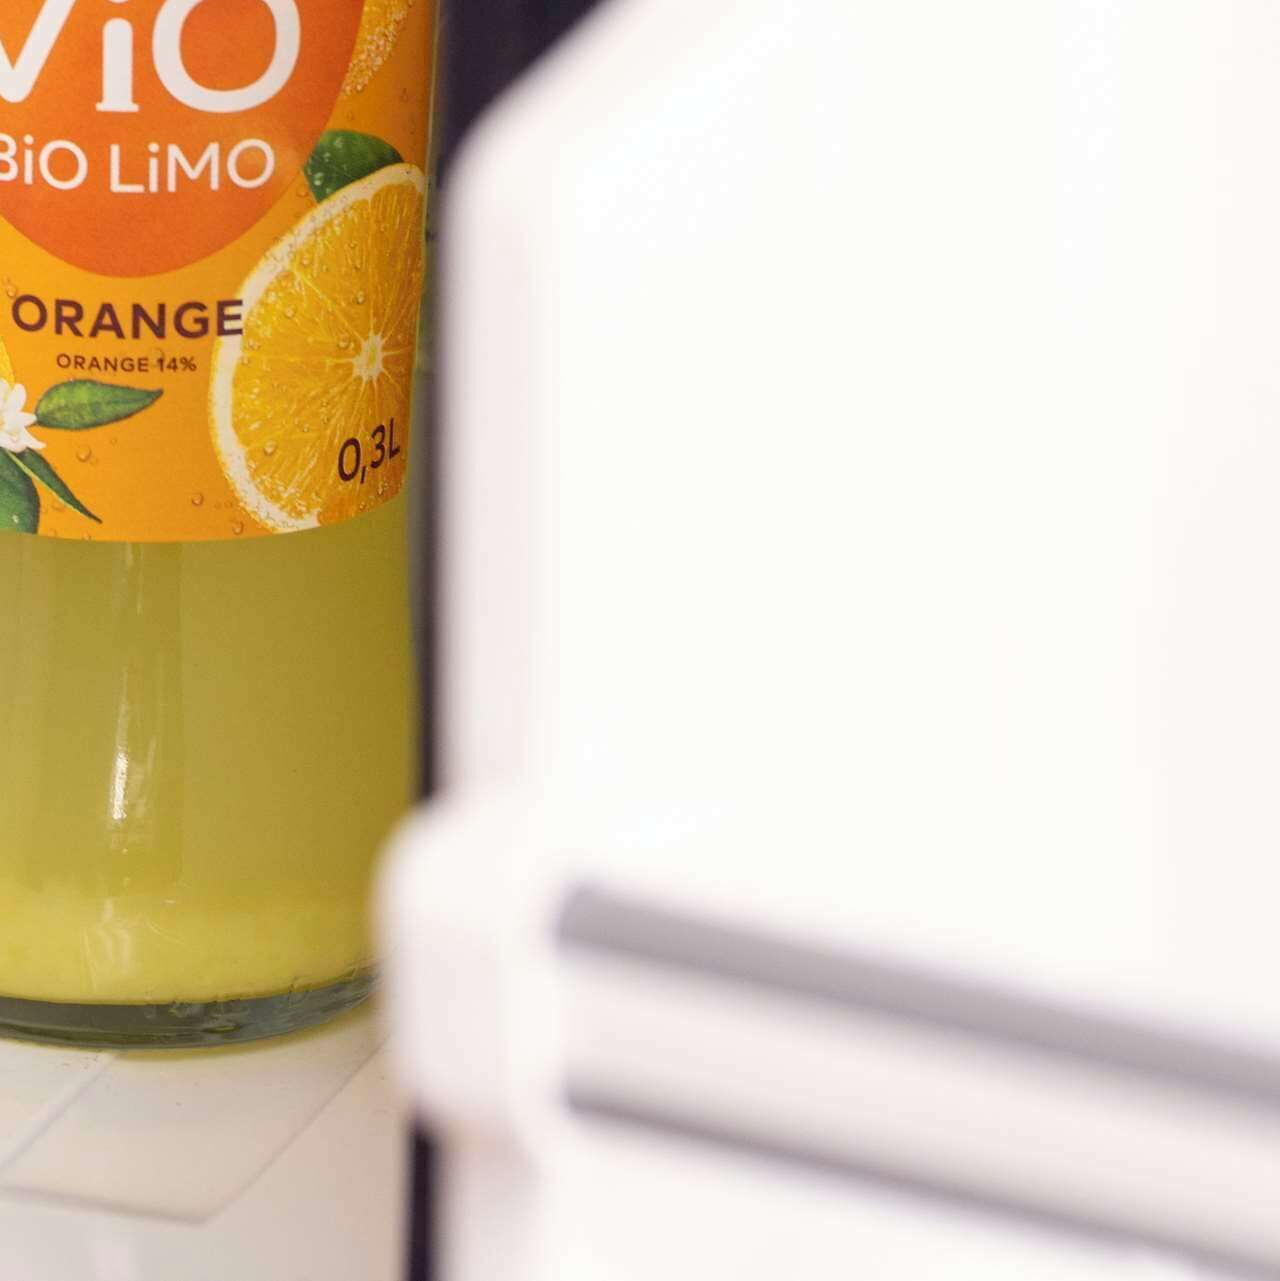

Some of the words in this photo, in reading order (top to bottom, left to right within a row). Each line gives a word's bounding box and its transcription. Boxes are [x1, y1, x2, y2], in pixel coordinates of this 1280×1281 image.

[11, 294, 244, 341] ORANGE
[56, 353, 149, 373] ORANGE
[156, 353, 197, 373] 14%
[337, 417, 402, 484] 0,3L
